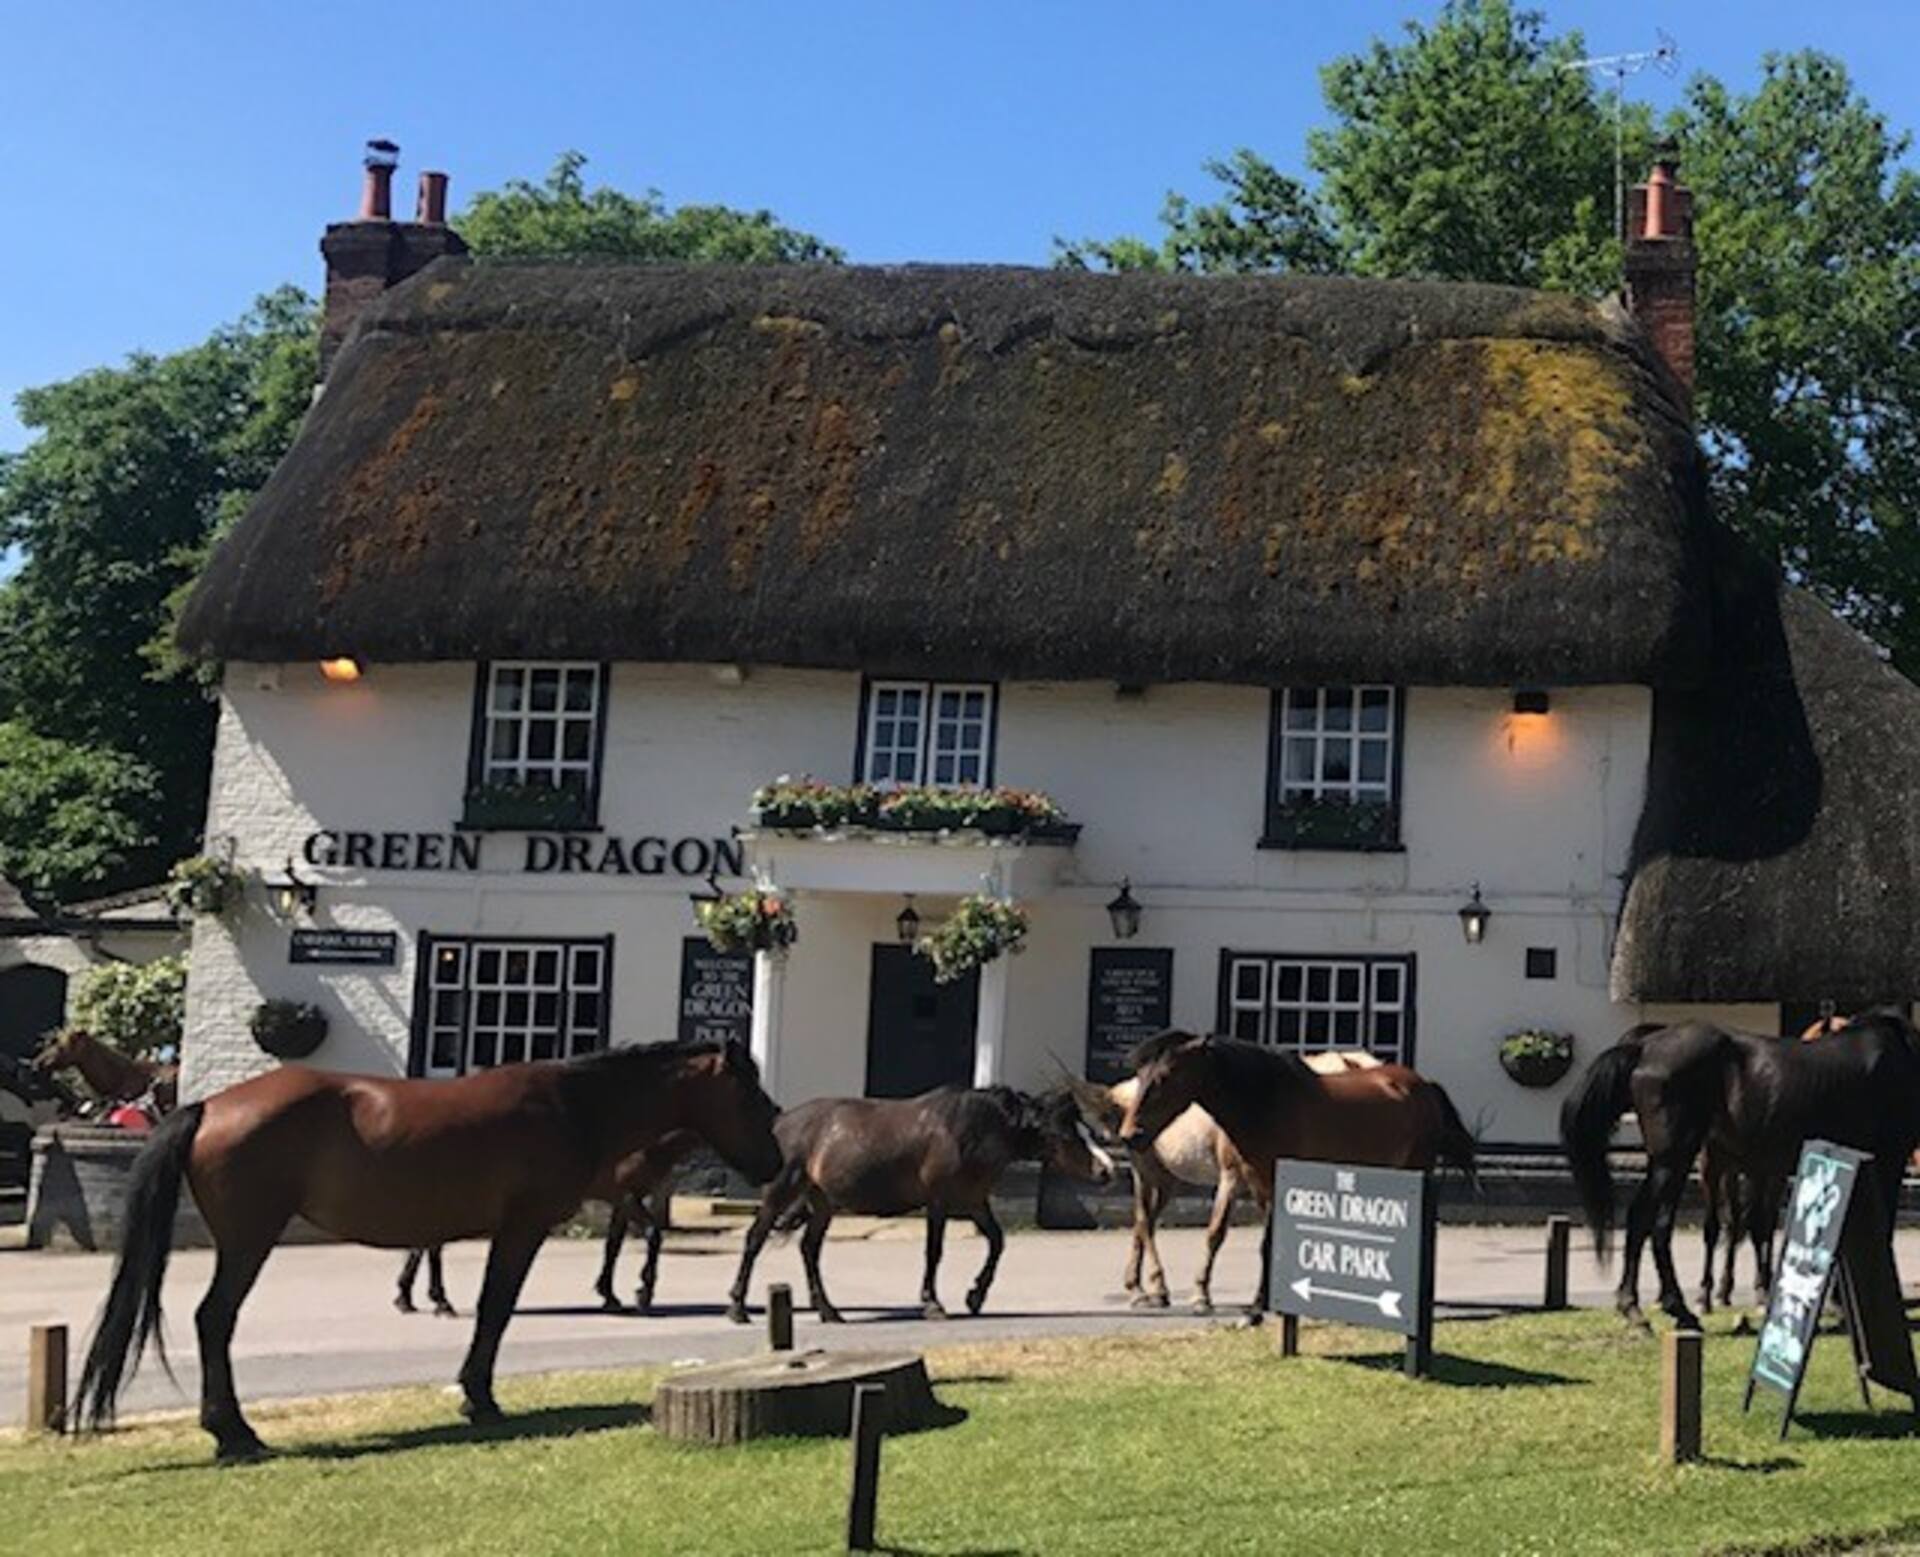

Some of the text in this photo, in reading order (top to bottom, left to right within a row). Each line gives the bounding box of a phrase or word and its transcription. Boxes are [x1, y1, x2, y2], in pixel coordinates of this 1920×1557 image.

[303, 830, 744, 877] GREEN DRAGON
[690, 982, 749, 999] GREEN
[684, 999, 753, 1018] DRAGON
[1337, 1171, 1356, 1192] THE
[1285, 1187, 1408, 1228] GREEN DRAGON
[1298, 1239, 1393, 1282] CAR PARK
